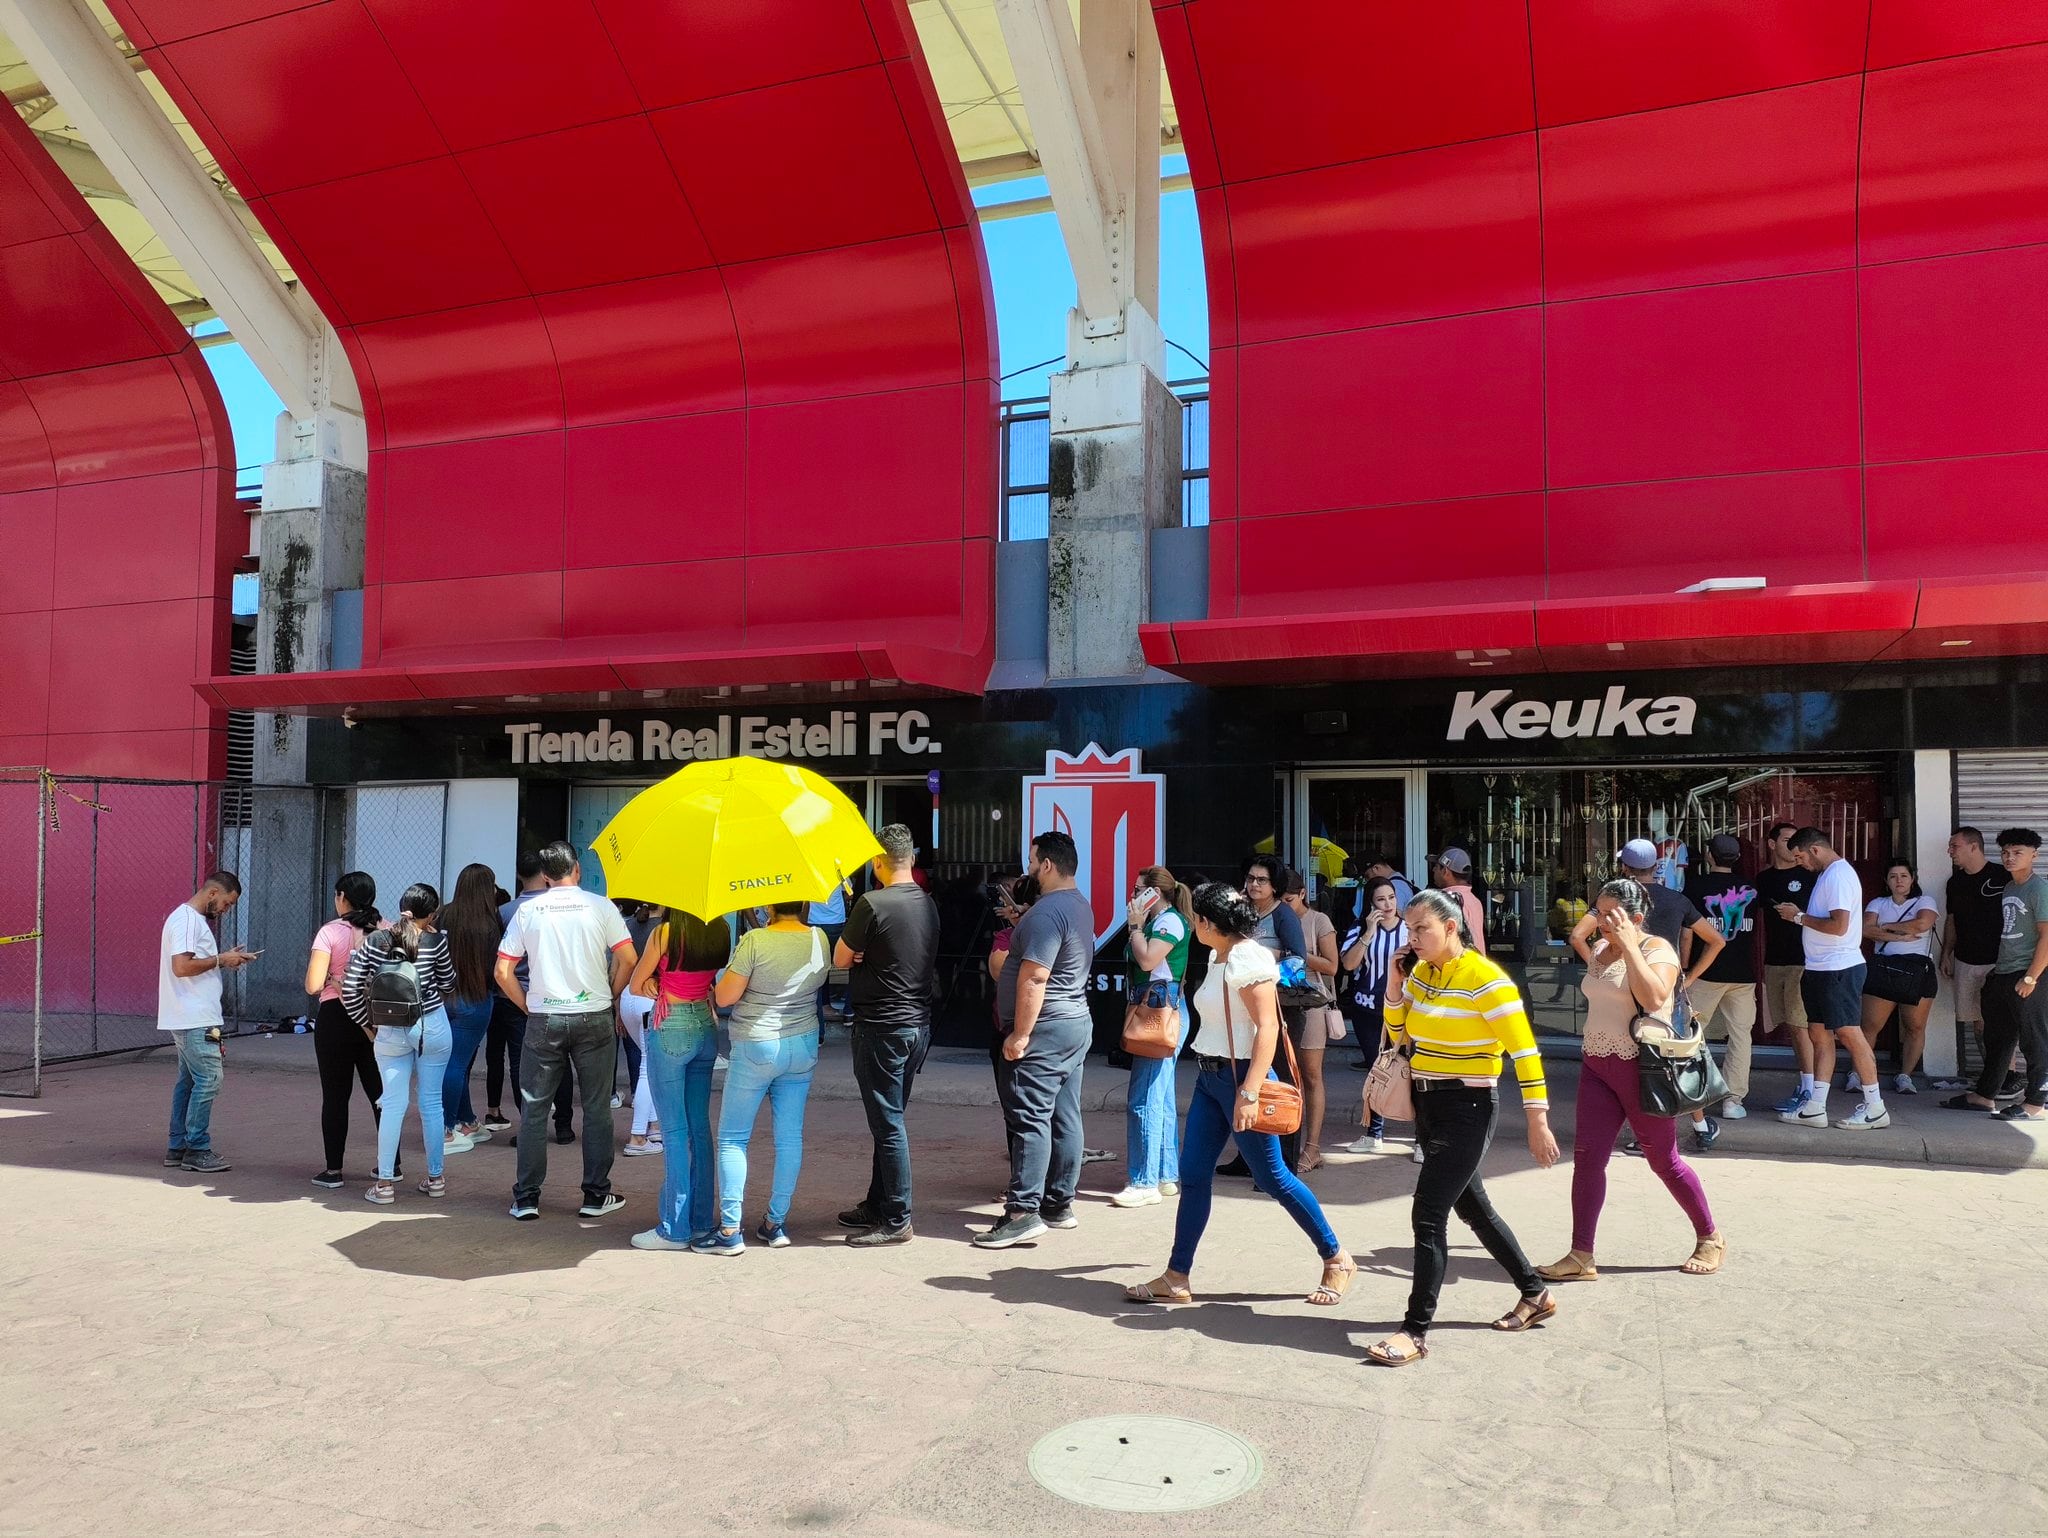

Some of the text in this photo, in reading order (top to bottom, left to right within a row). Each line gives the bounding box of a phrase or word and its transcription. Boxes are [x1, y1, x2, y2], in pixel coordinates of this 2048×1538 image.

[505, 710, 943, 764] Tienda Real Esteli FC.
[1446, 685, 1697, 741] Keuka
[728, 872, 793, 892] STANLEY
